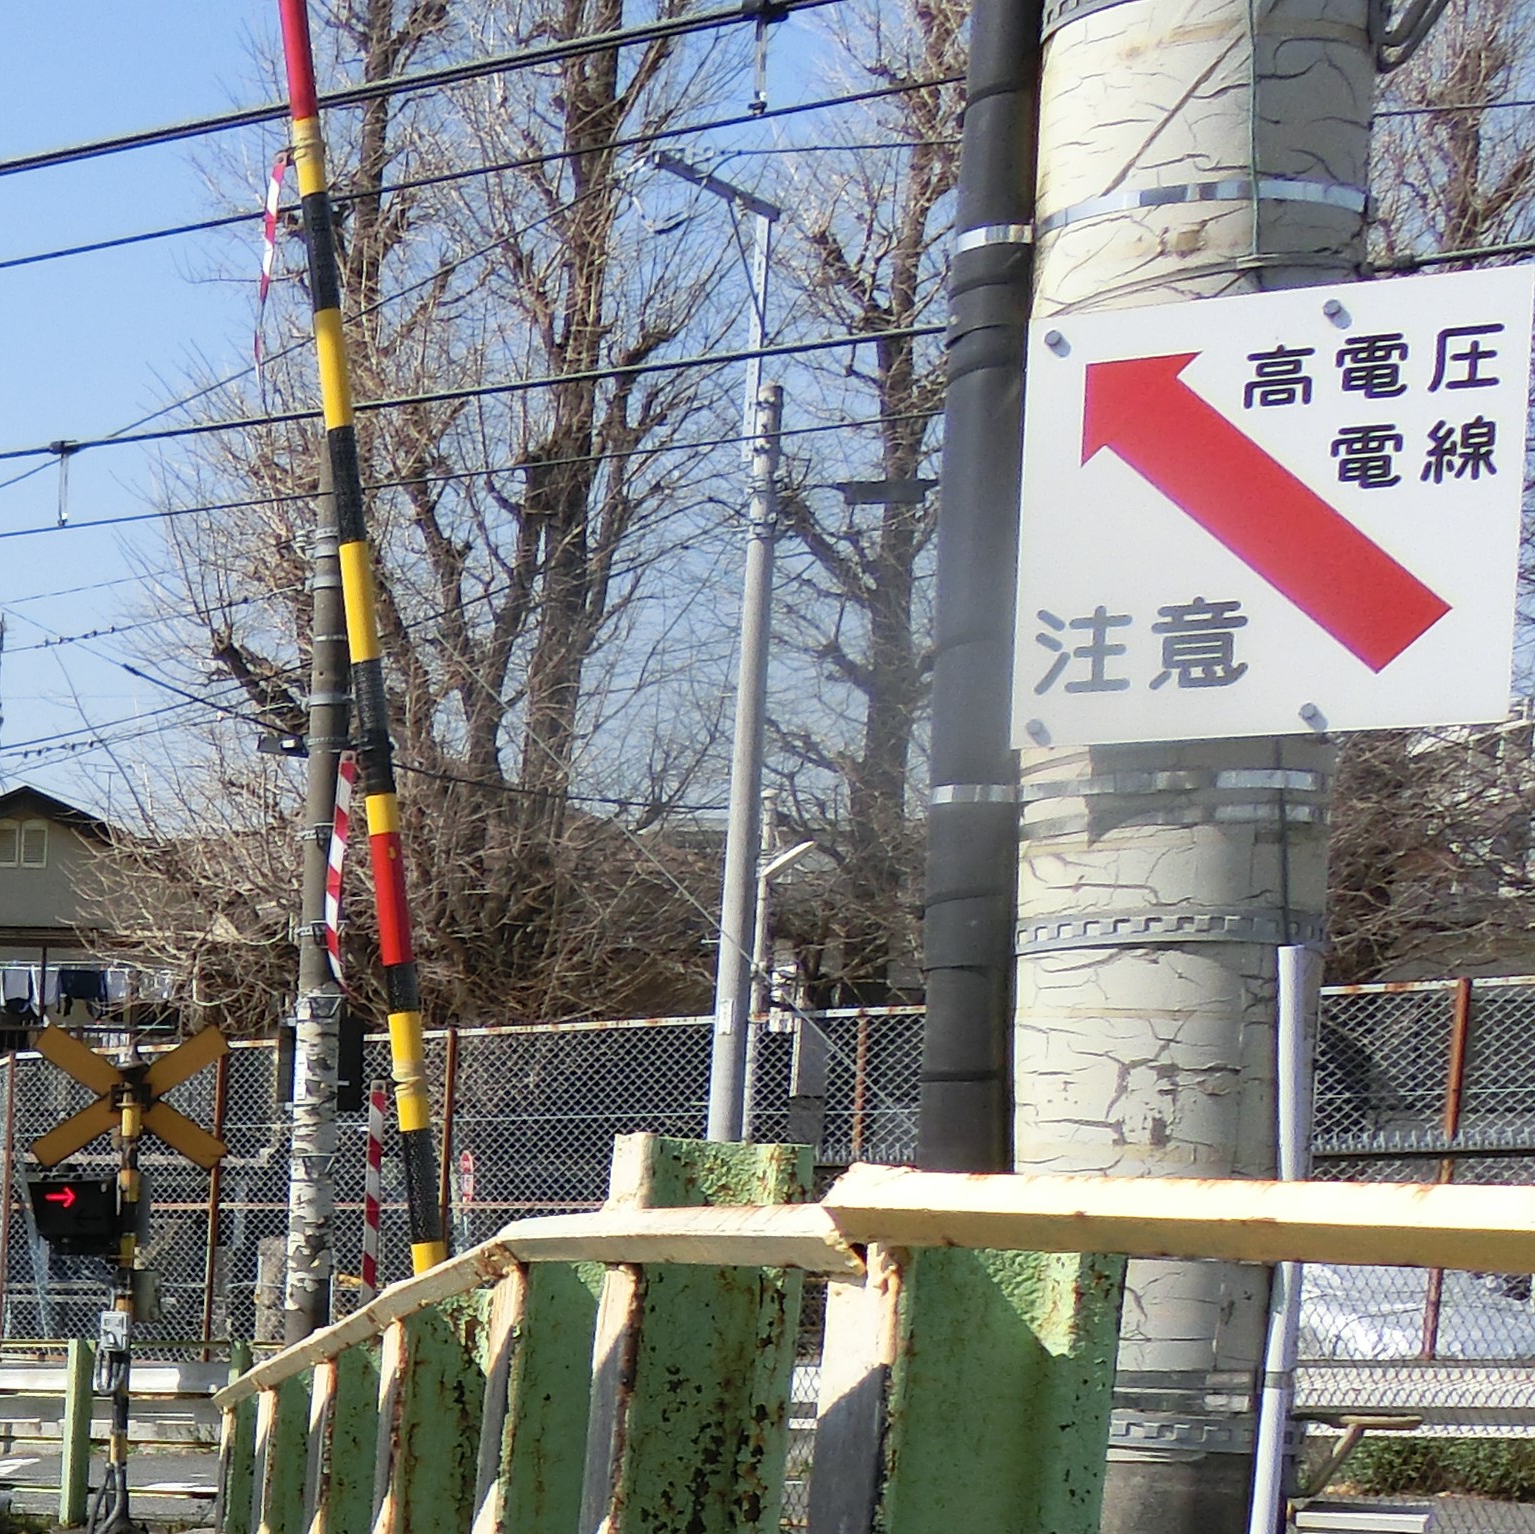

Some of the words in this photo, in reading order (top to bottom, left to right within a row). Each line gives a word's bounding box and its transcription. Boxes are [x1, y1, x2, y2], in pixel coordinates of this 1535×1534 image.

[1242, 321, 1508, 410] 高電圧
[1329, 414, 1498, 490] 電線
[1033, 596, 1249, 697] 注意
